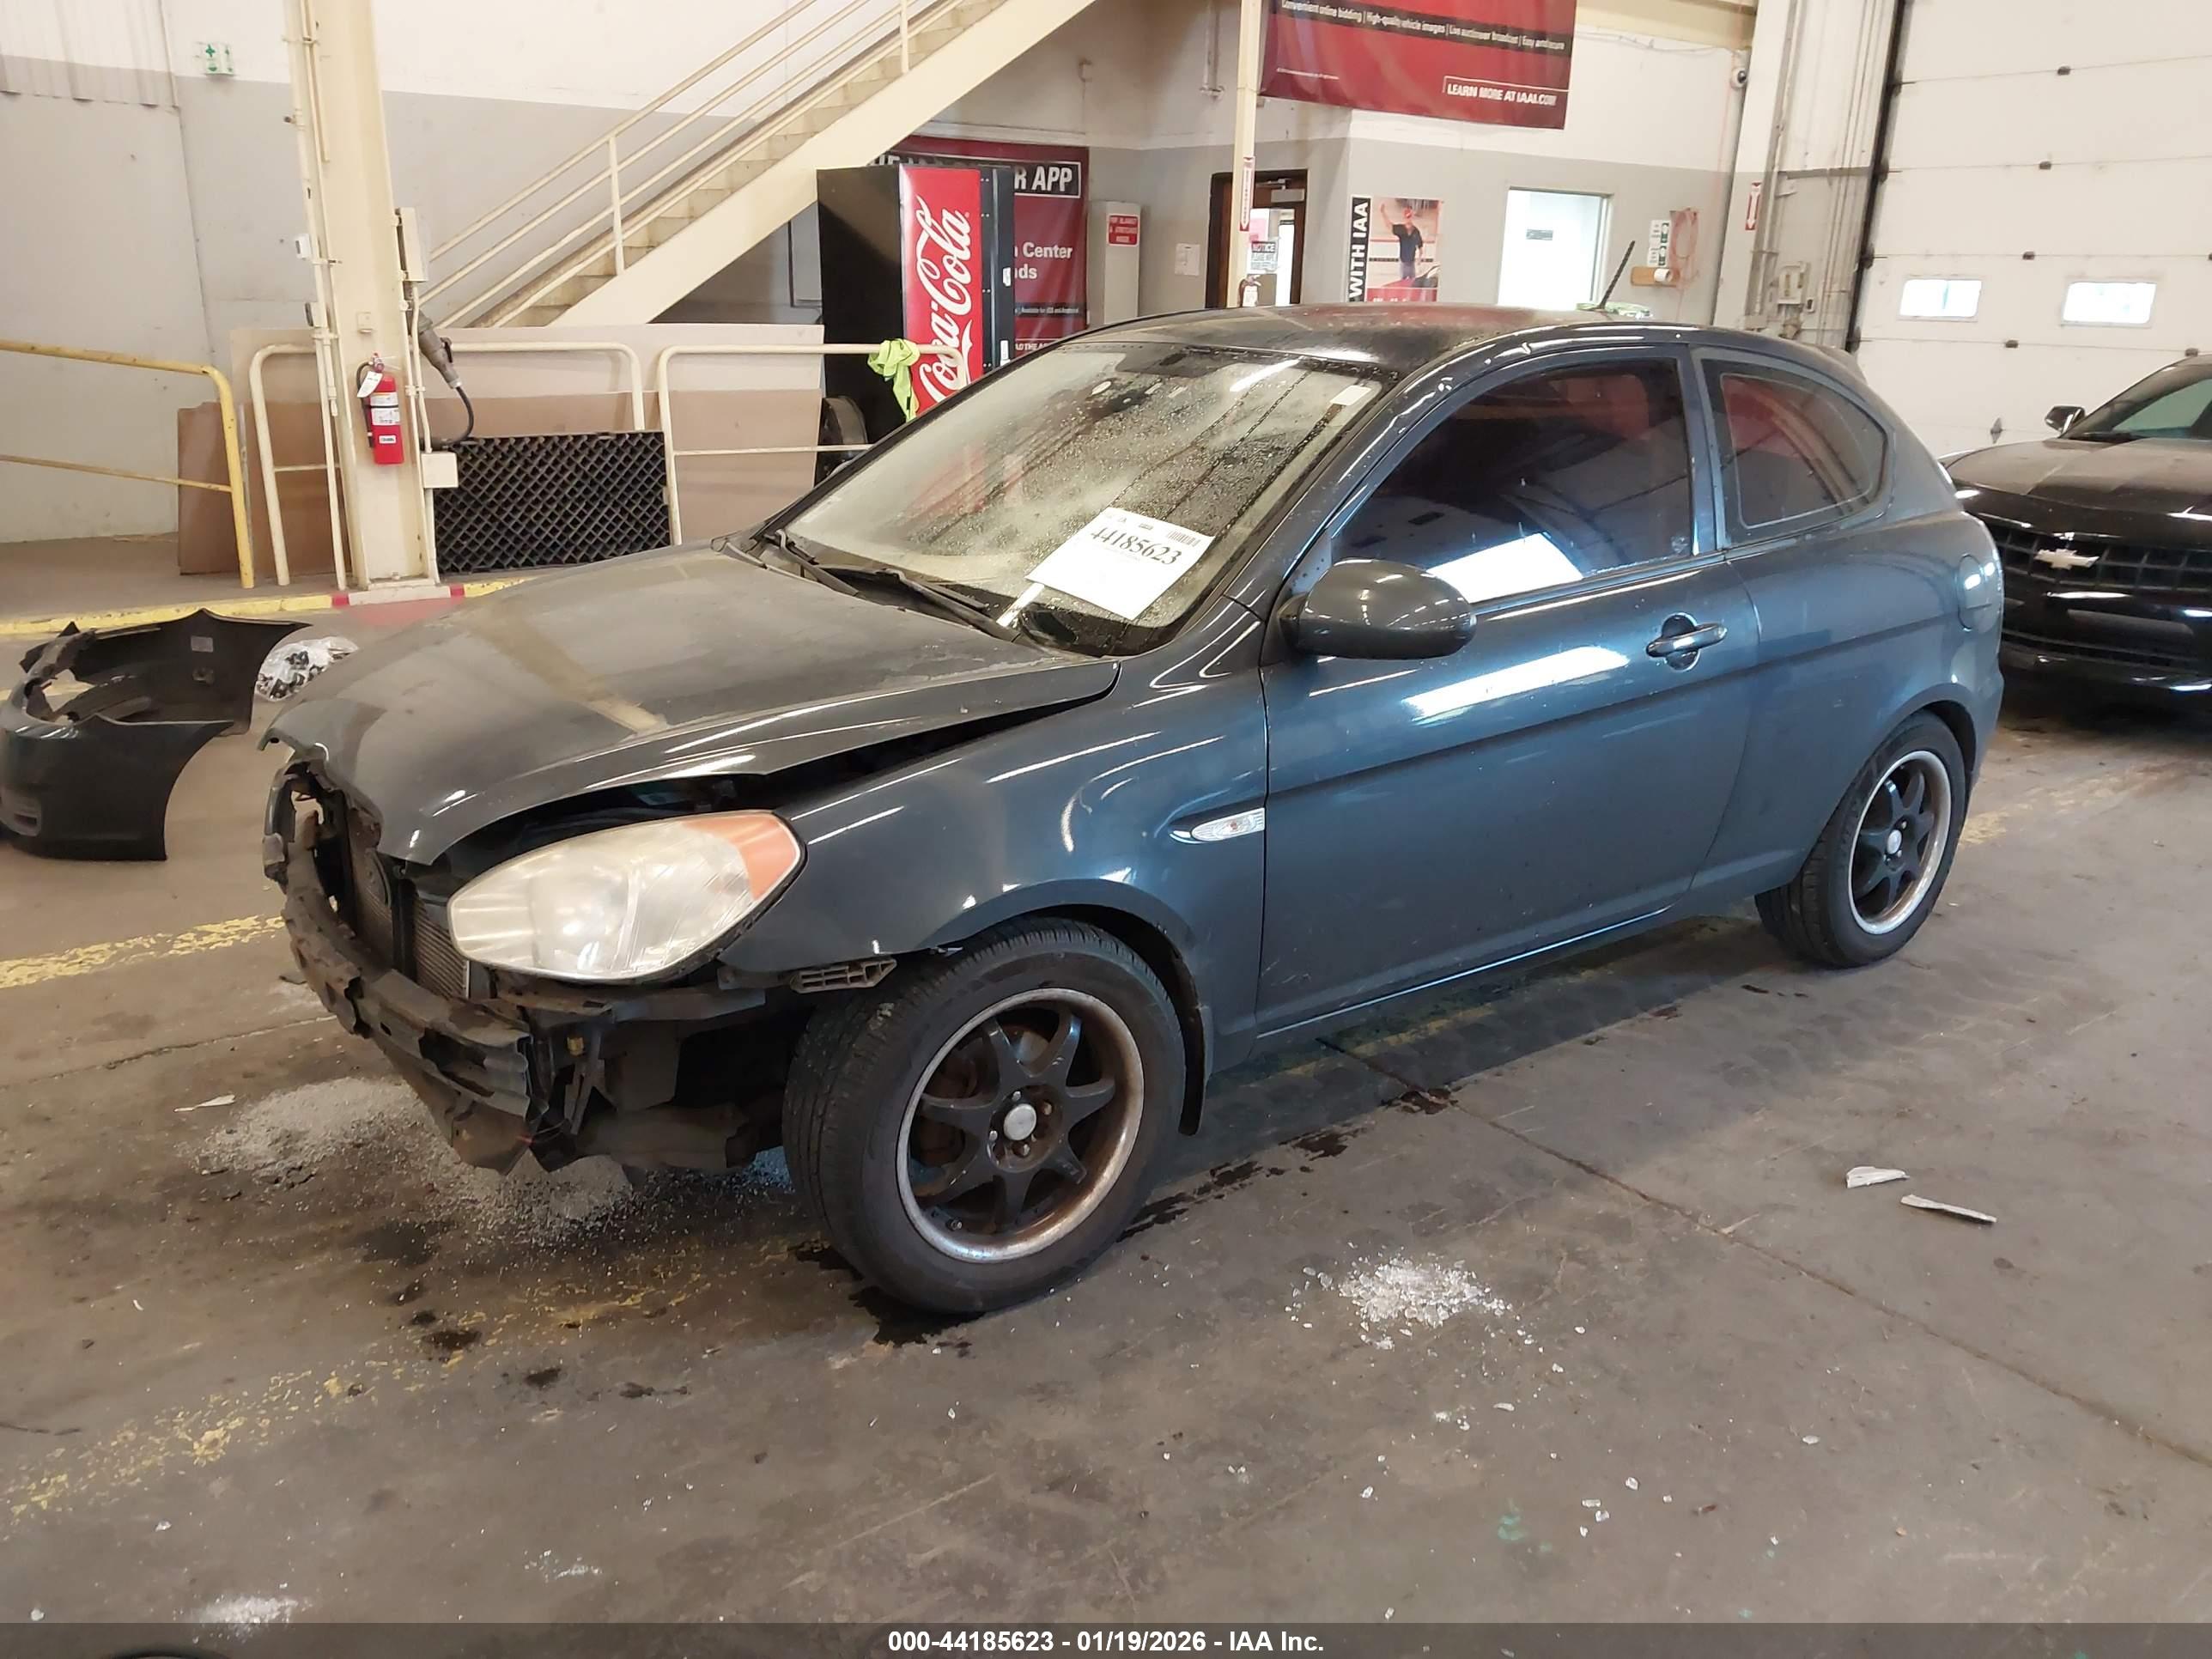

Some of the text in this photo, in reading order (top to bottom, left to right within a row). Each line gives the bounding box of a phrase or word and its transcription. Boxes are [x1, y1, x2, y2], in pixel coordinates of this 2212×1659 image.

[1447, 83, 1478, 97] LEARN
[1479, 87, 1504, 100] MORE
[1504, 90, 1516, 101] AT
[1031, 166, 1073, 191] APP
[1023, 242, 1073, 259] Center
[1349, 203, 1369, 299] WITH IAA
[1091, 527, 1182, 565] 44185623
